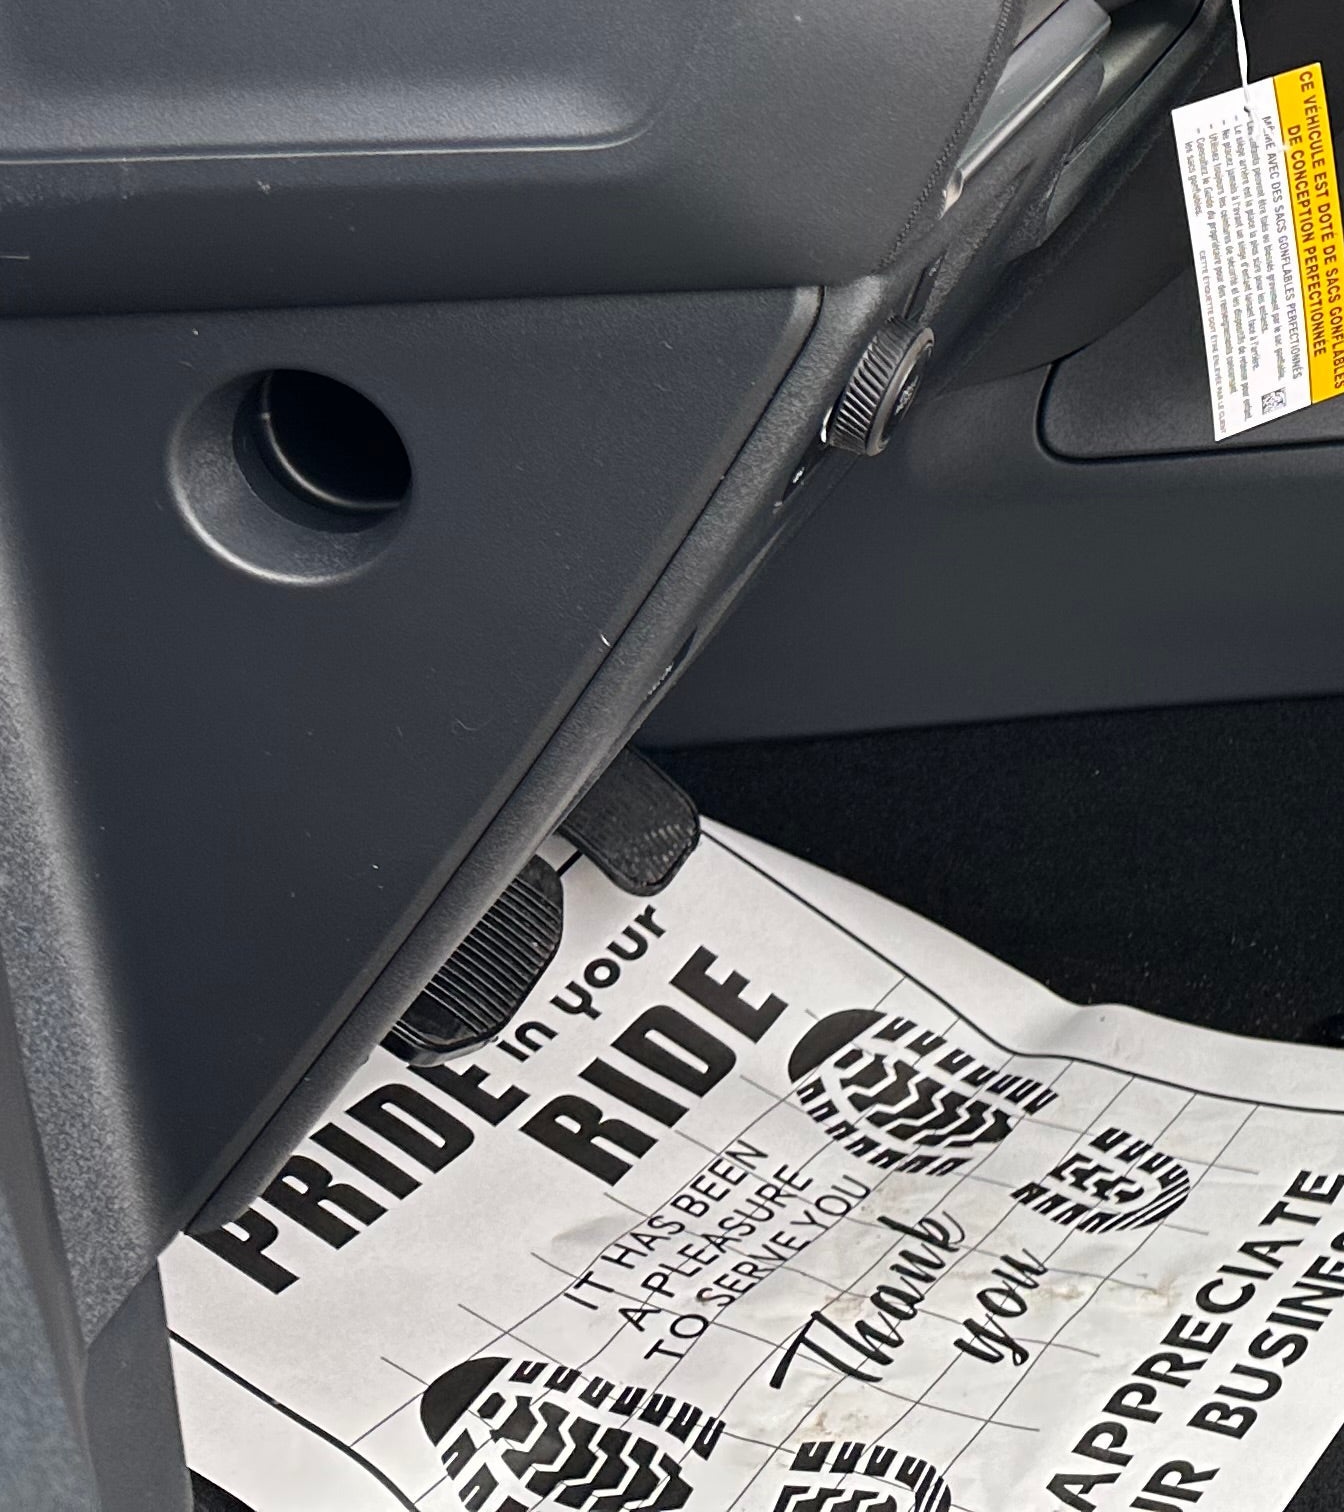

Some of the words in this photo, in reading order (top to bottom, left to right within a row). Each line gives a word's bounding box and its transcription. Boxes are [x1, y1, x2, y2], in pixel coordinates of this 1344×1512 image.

[1299, 71, 1314, 92] CE
[1267, 152, 1279, 179] AVEC
[1287, 124, 1302, 145] DE
[1303, 95, 1324, 168] VÉHICULE
[1271, 181, 1282, 202] DES
[1274, 204, 1286, 233] SACS
[1291, 150, 1313, 242] CONCEPTION
[1314, 171, 1328, 196] EST
[1317, 202, 1334, 241] DOTÉ
[1323, 244, 1336, 264] DE
[1278, 235, 1294, 300] GONFLABLES
[1304, 246, 1326, 355] PERFECTIONNÉE
[1325, 267, 1340, 303] SACS
[1286, 302, 1302, 378] PERFECTIONNÉS
[184, 1060, 531, 1294] PRIDE
[496, 1019, 558, 1063] in
[550, 904, 667, 1021] your
[519, 945, 789, 1187] RIDE
[563, 1270, 615, 1311] IT
[600, 1214, 686, 1270] HAS
[670, 1138, 769, 1219] BEEN
[618, 1305, 662, 1333] A
[640, 1163, 814, 1299] PLEASURE
[643, 1312, 710, 1360] TO
[695, 1230, 811, 1308] SERVE
[789, 1174, 872, 1233] YOU
[768, 1210, 966, 1390] Thank
[952, 1247, 1049, 1367] you
